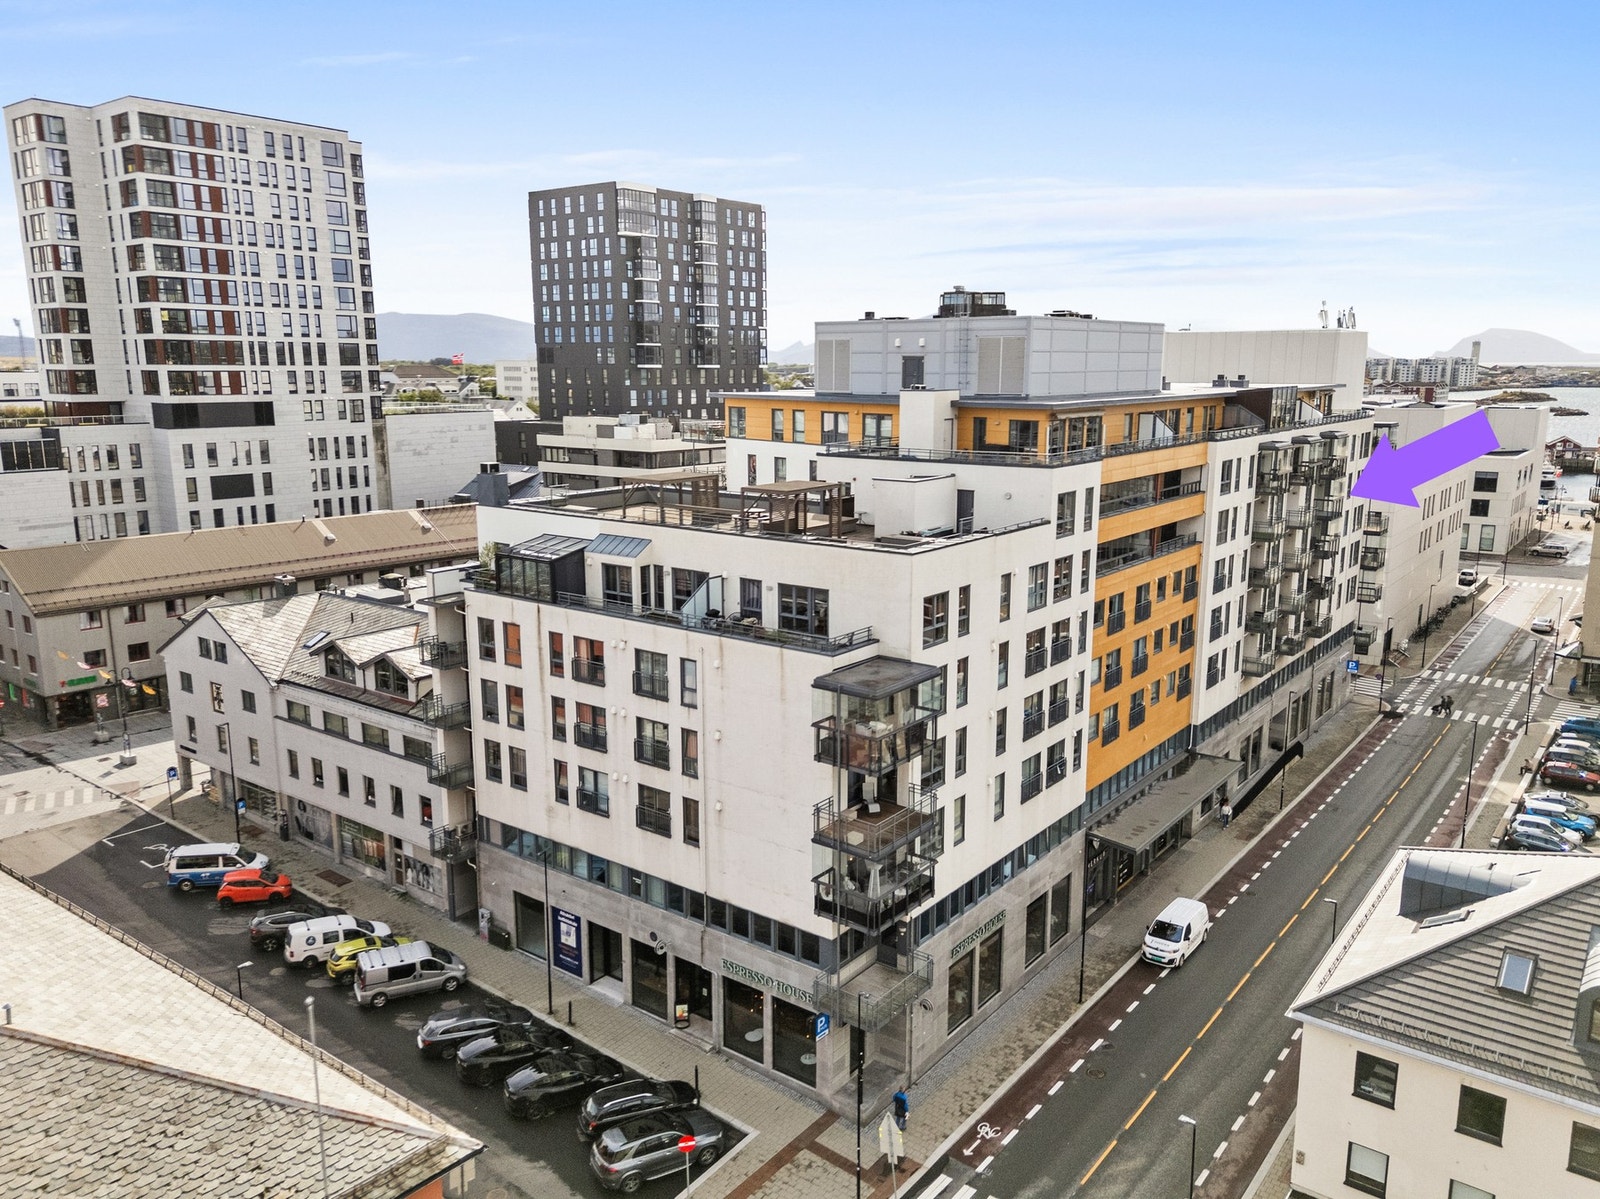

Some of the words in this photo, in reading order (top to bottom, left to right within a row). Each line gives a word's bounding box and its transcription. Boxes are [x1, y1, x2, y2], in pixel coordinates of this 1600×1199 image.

[721, 958, 774, 987] ESPRESSO
[774, 980, 813, 1004] HOUSE
[817, 1016, 826, 1033] P
